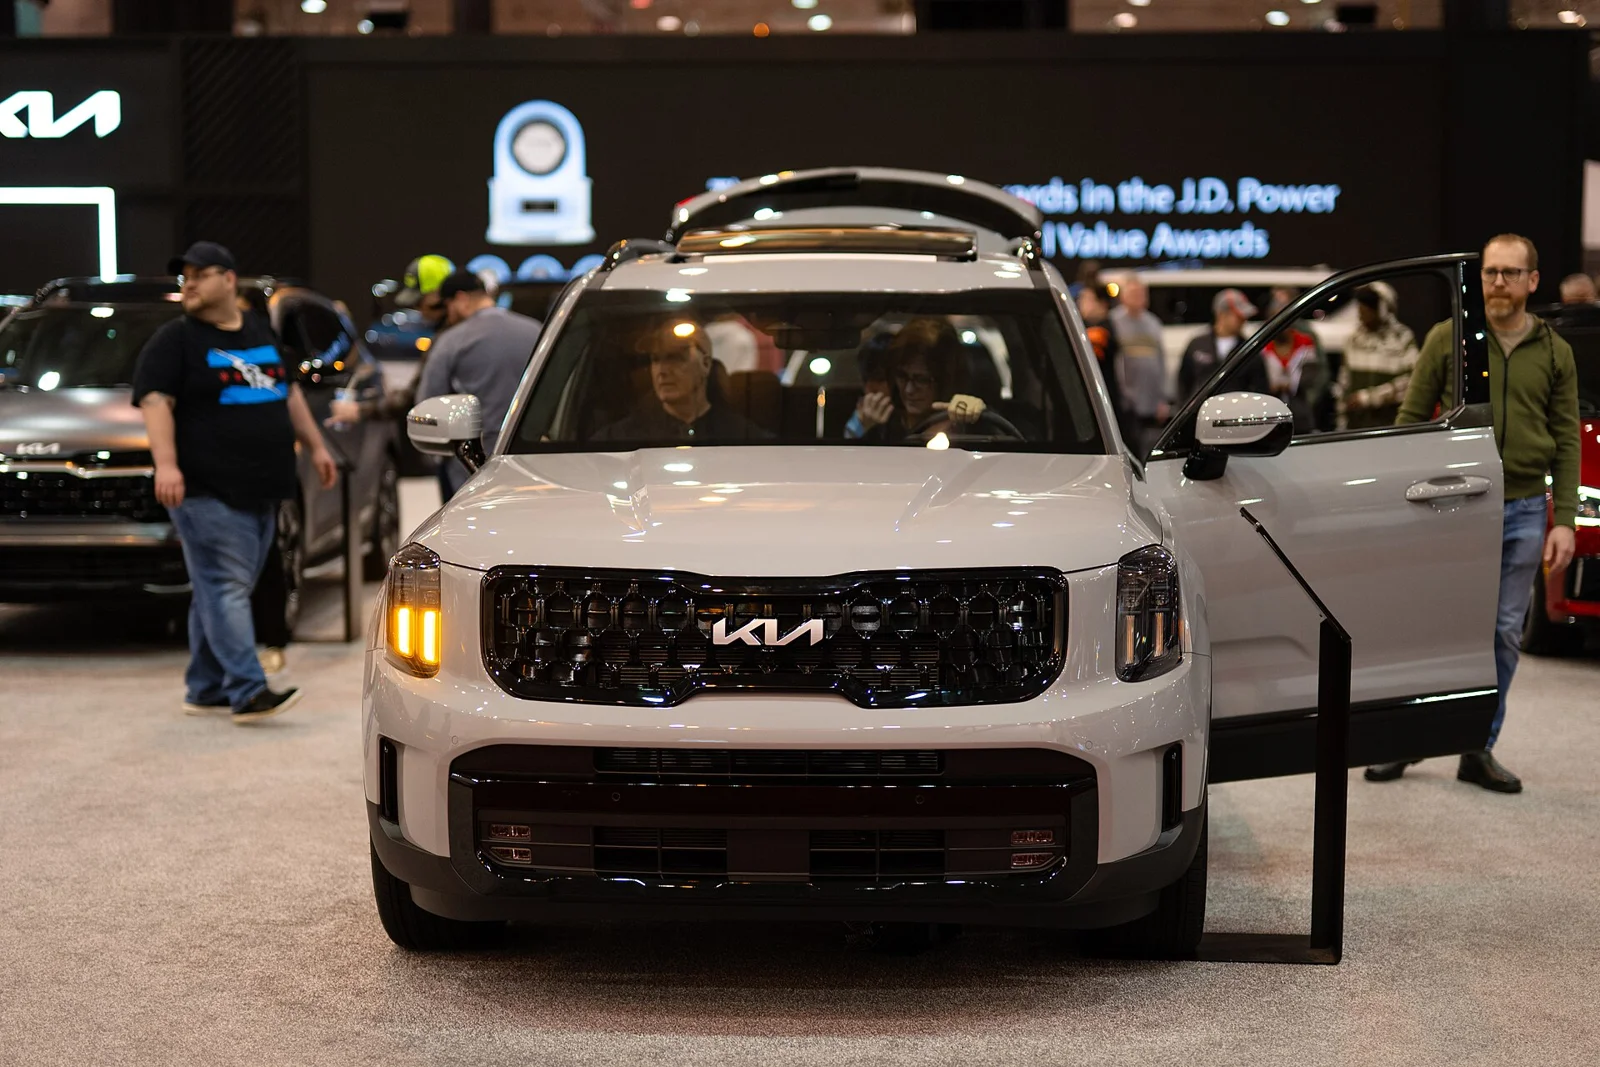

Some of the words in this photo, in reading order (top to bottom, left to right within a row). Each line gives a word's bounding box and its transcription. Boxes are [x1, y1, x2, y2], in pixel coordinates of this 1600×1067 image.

[1080, 177, 1115, 214] in
[1117, 176, 1175, 214] the
[1175, 177, 1235, 214] J.D.
[1237, 177, 1341, 214] Power
[1056, 220, 1148, 259] Value
[1149, 220, 1270, 259] Awards
[712, 617, 824, 646] KIA
